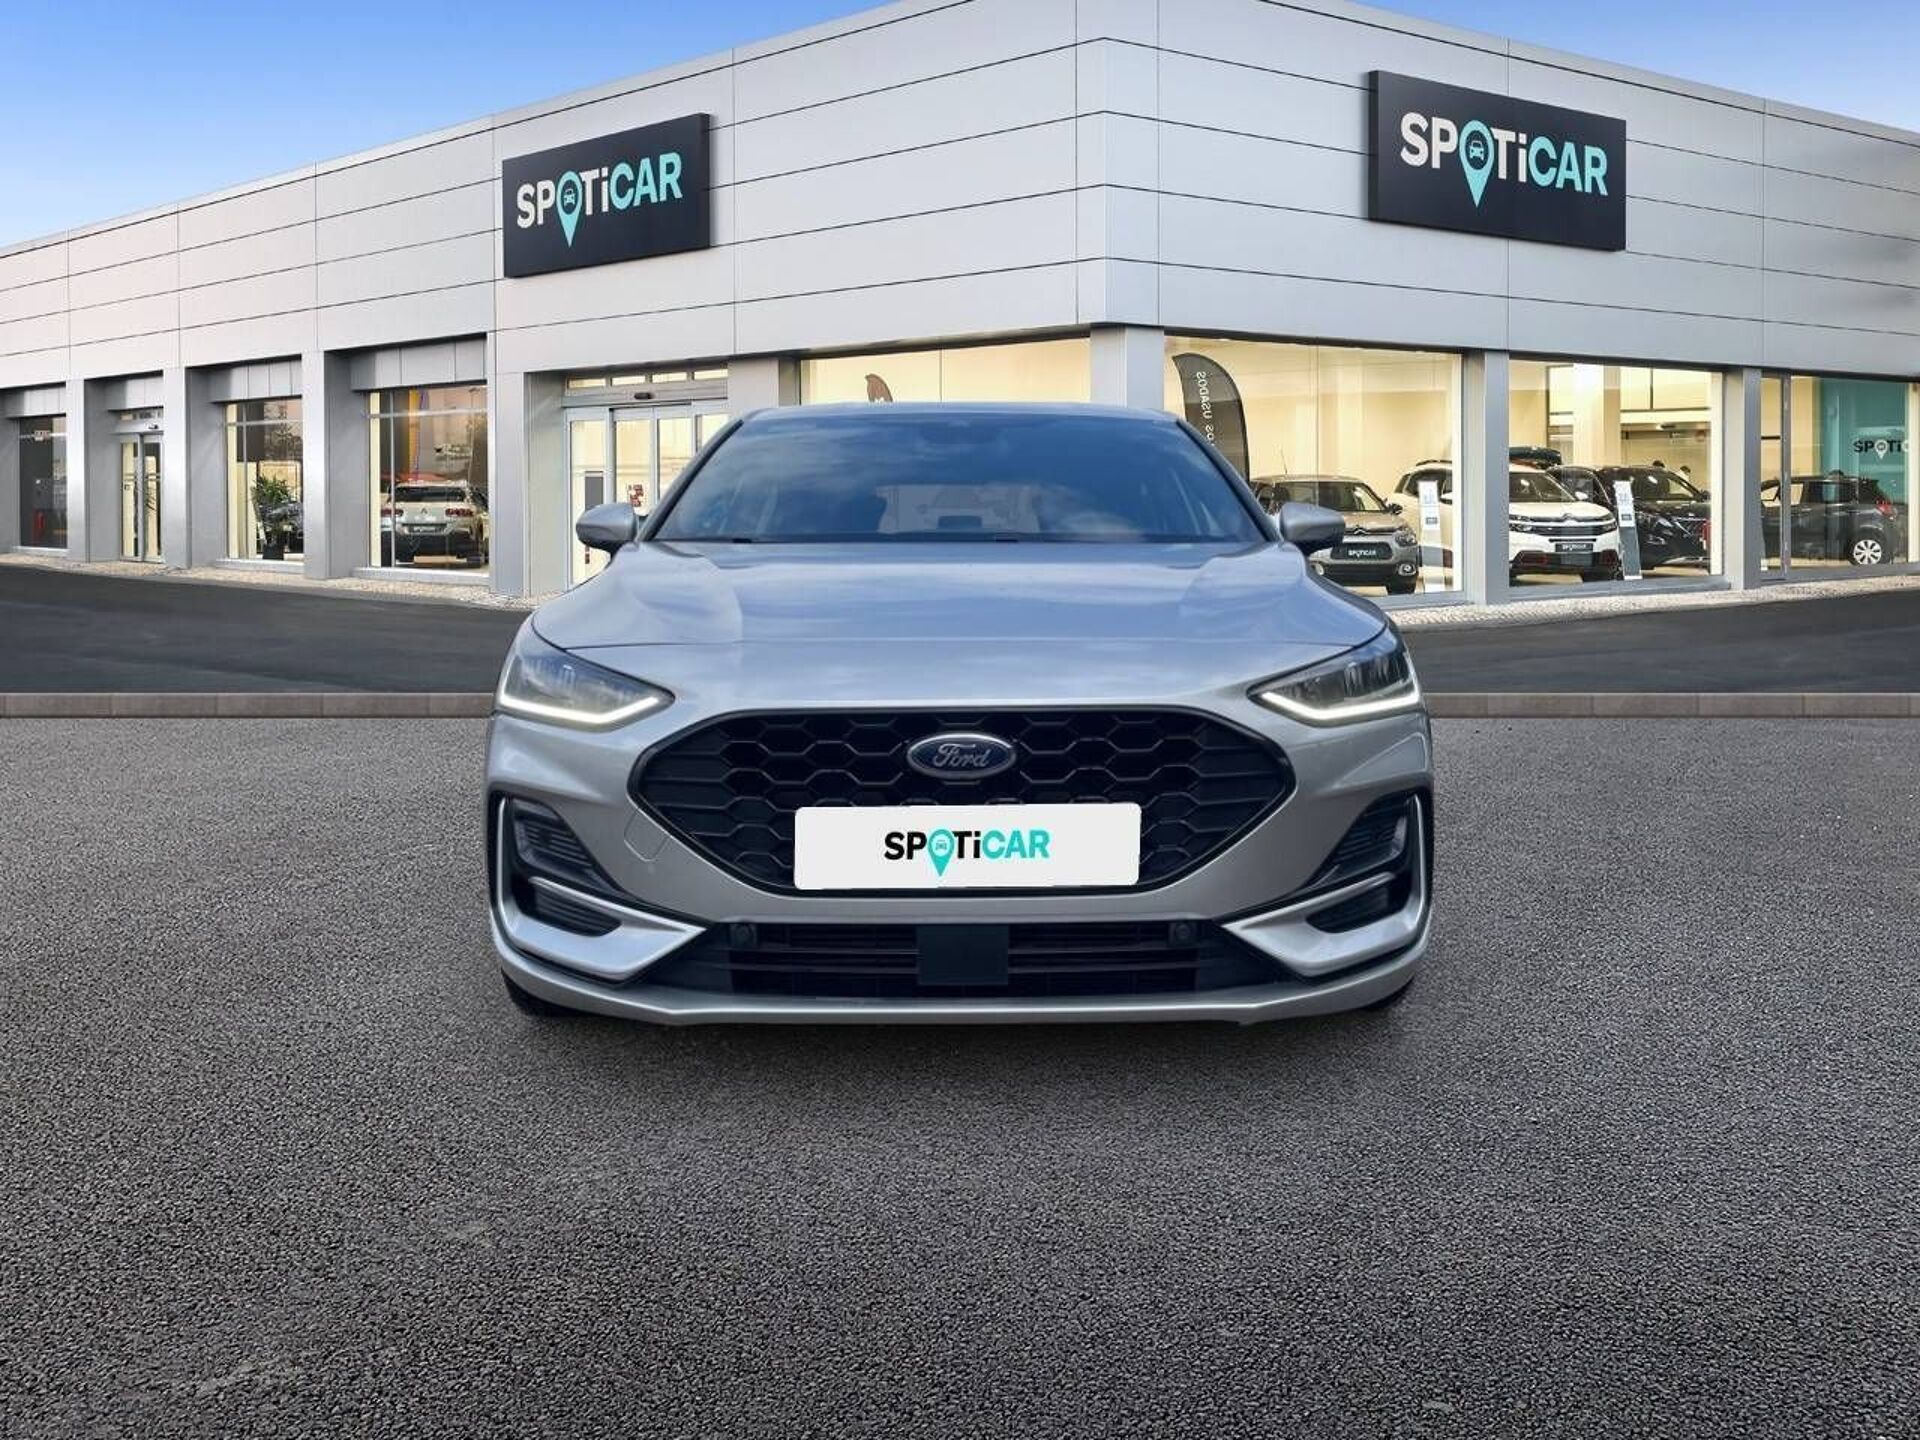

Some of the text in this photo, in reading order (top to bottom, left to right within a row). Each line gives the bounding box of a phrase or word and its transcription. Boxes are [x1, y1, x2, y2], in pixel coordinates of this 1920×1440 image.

[1401, 112, 1608, 207] SPOTiCAR
[517, 152, 683, 247] SPOTiCAR
[932, 743, 990, 768] Ford
[884, 829, 1049, 877] SPOTiCAR
